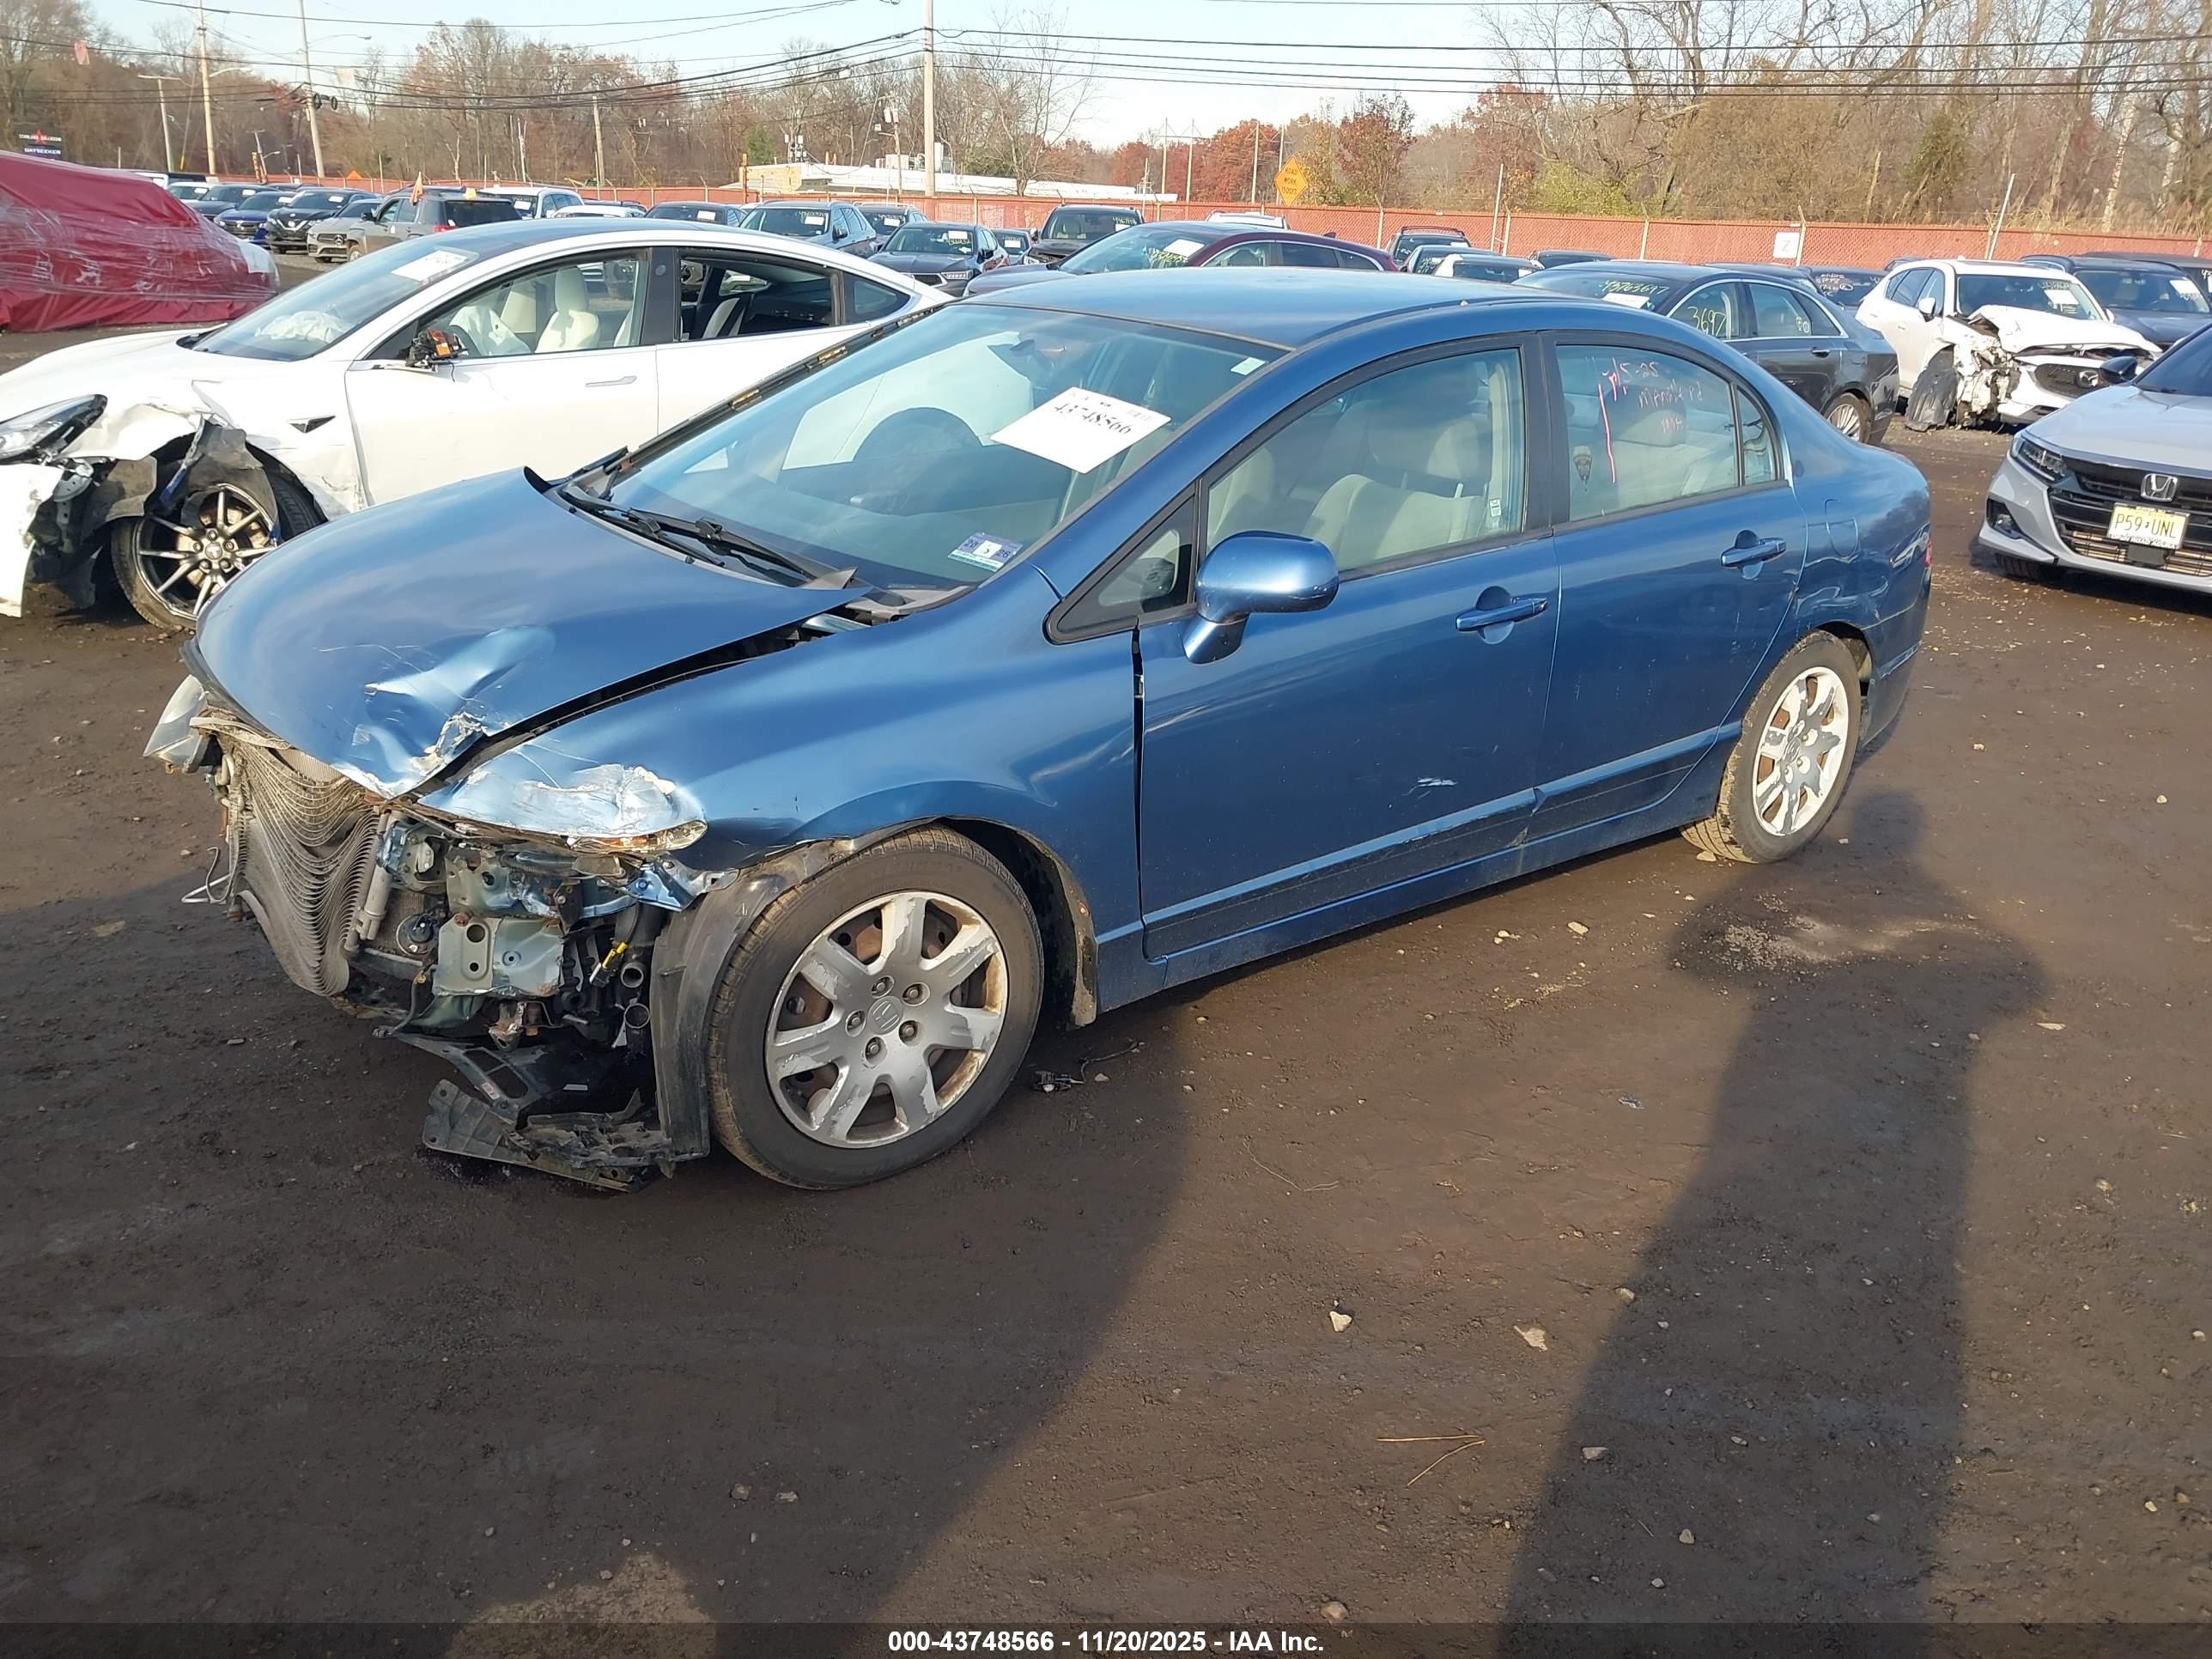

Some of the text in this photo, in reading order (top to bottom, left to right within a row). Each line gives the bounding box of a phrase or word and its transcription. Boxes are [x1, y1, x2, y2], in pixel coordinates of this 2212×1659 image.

[1687, 306, 1726, 337] 3697
[2115, 514, 2177, 538] P59 UNL
